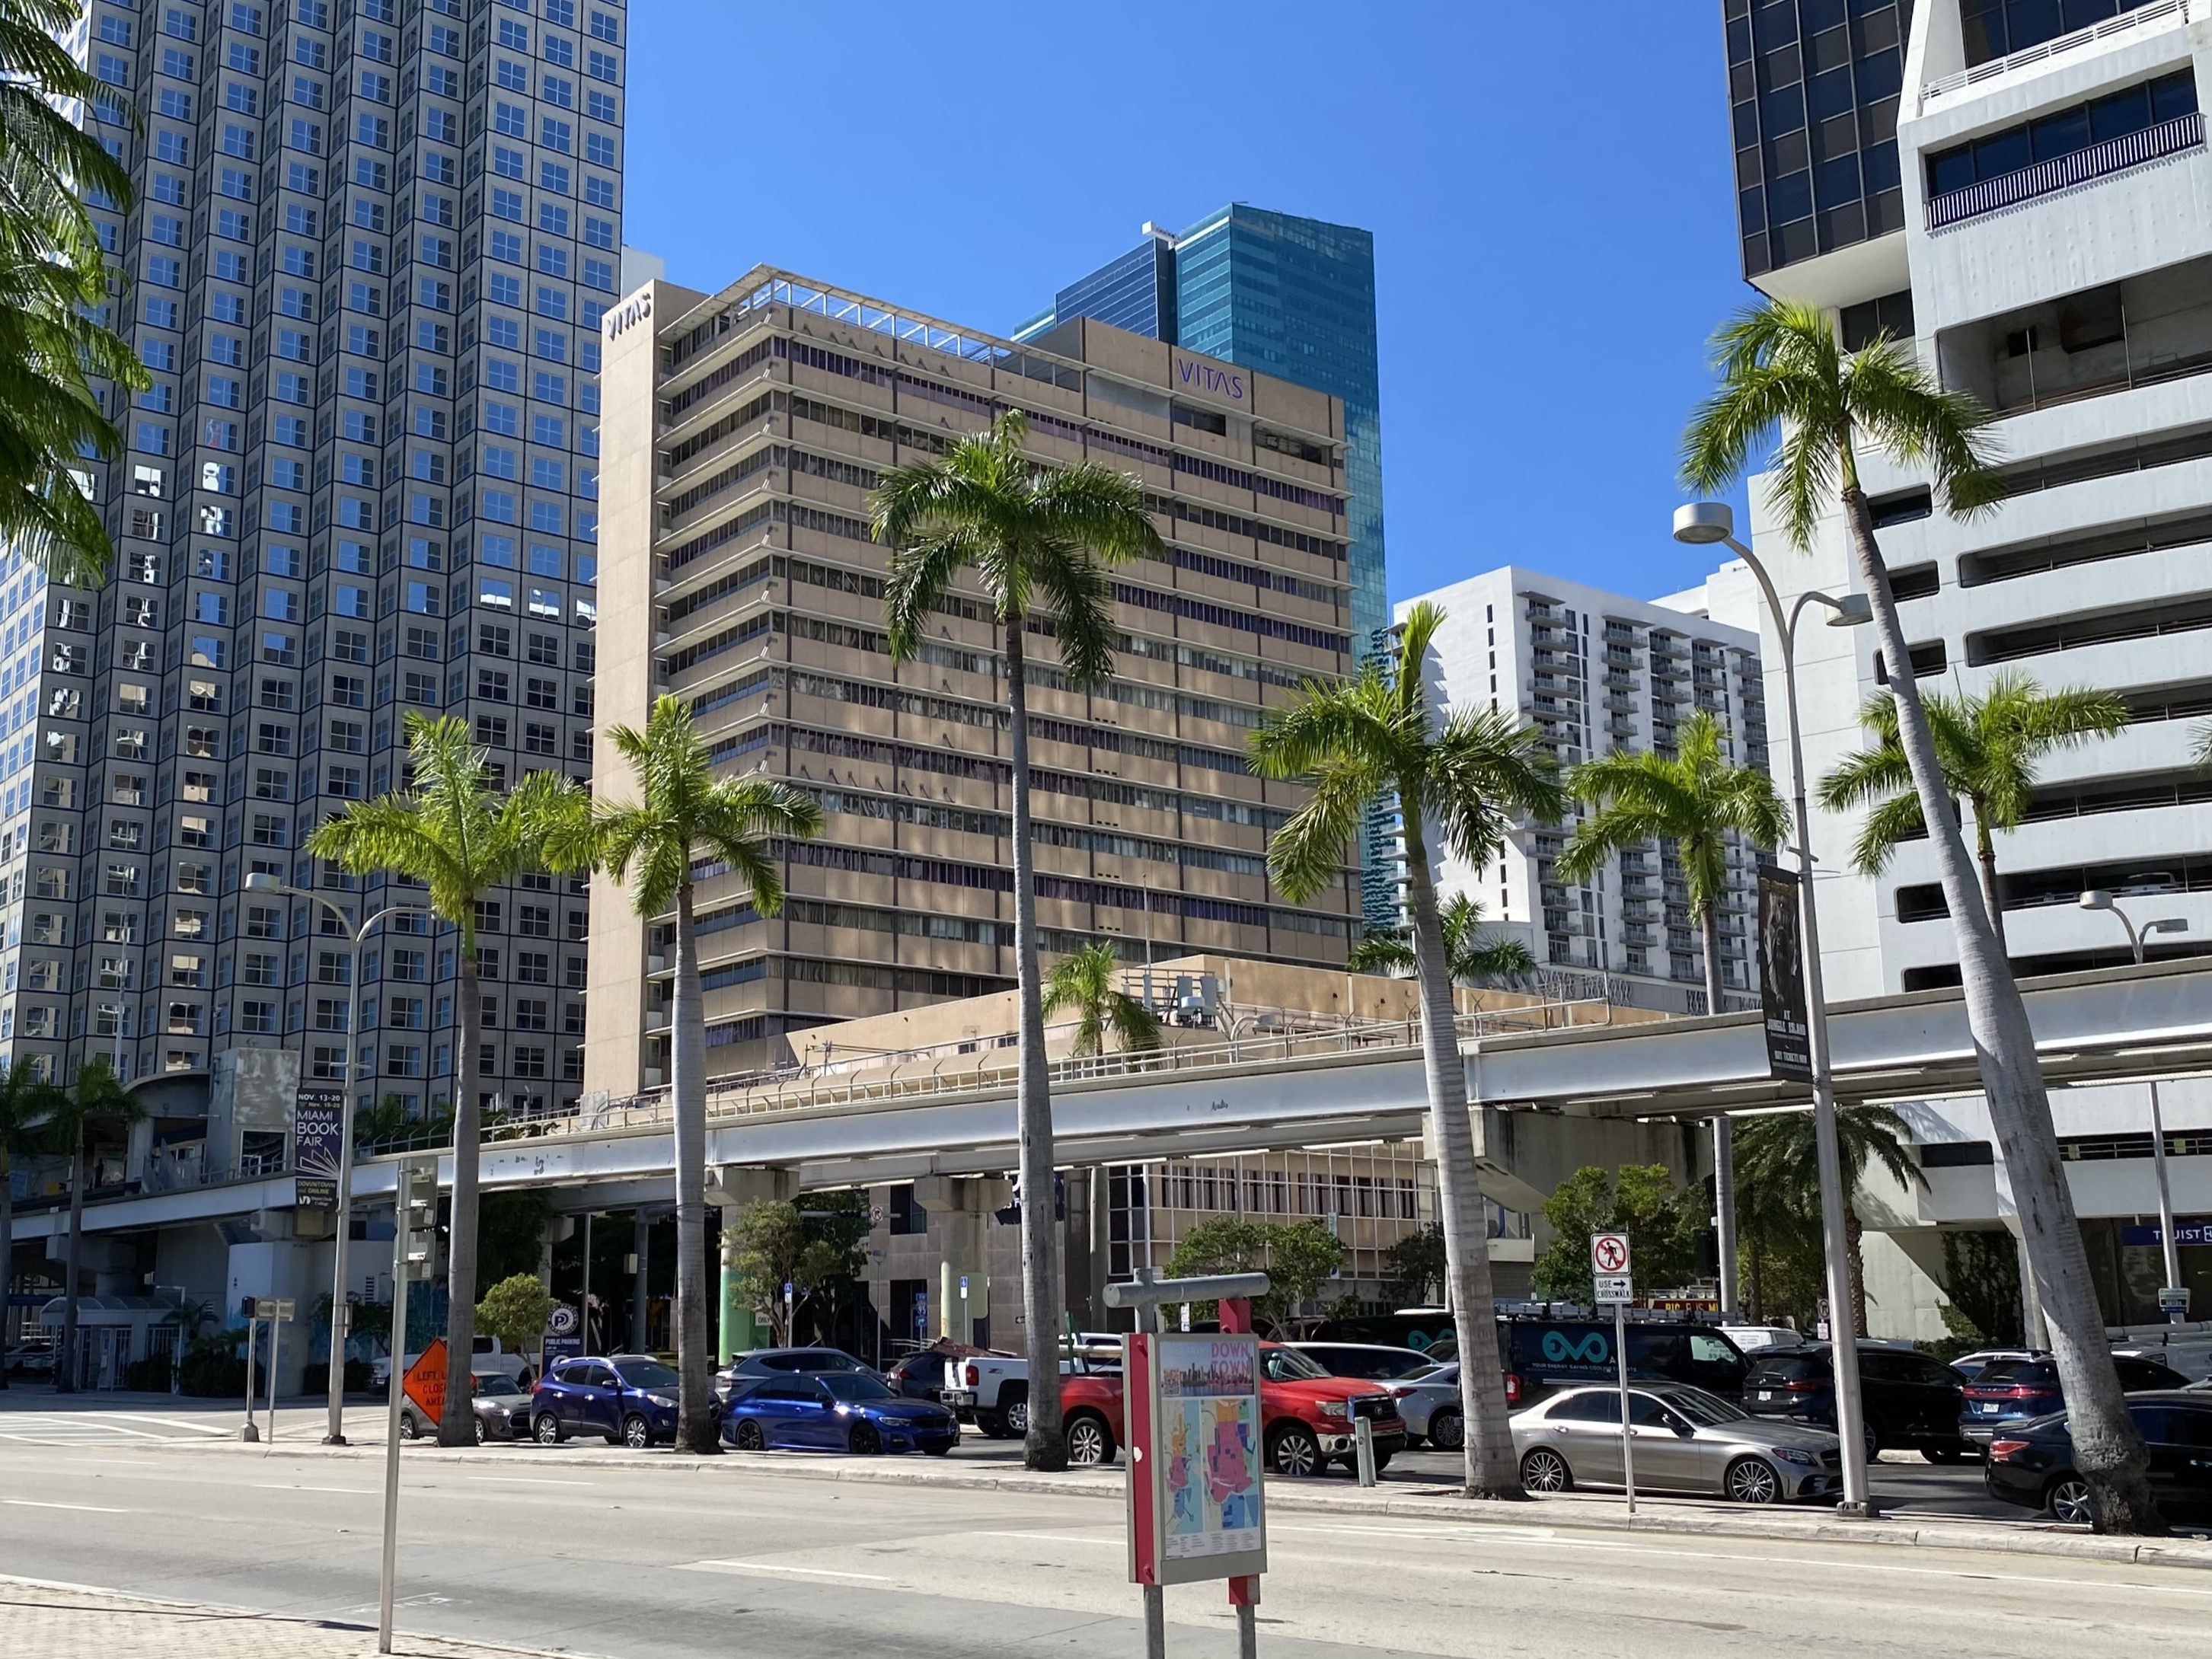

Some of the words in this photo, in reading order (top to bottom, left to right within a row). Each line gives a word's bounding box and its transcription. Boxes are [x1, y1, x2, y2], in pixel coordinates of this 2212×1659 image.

[606, 292, 651, 341] VITAS
[1178, 358, 1243, 399] VITAS
[297, 1110, 333, 1121] MIAMI
[297, 1121, 339, 1136] BOOK
[296, 1136, 322, 1147] FAIR
[1599, 1280, 1612, 1288] USE
[1597, 1288, 1631, 1299] CROSSWALK
[918, 1305, 926, 1315] 95
[1211, 1342, 1249, 1358] DOWN
[1211, 1360, 1250, 1375] TOWN
[417, 1371, 436, 1382] LEFT
